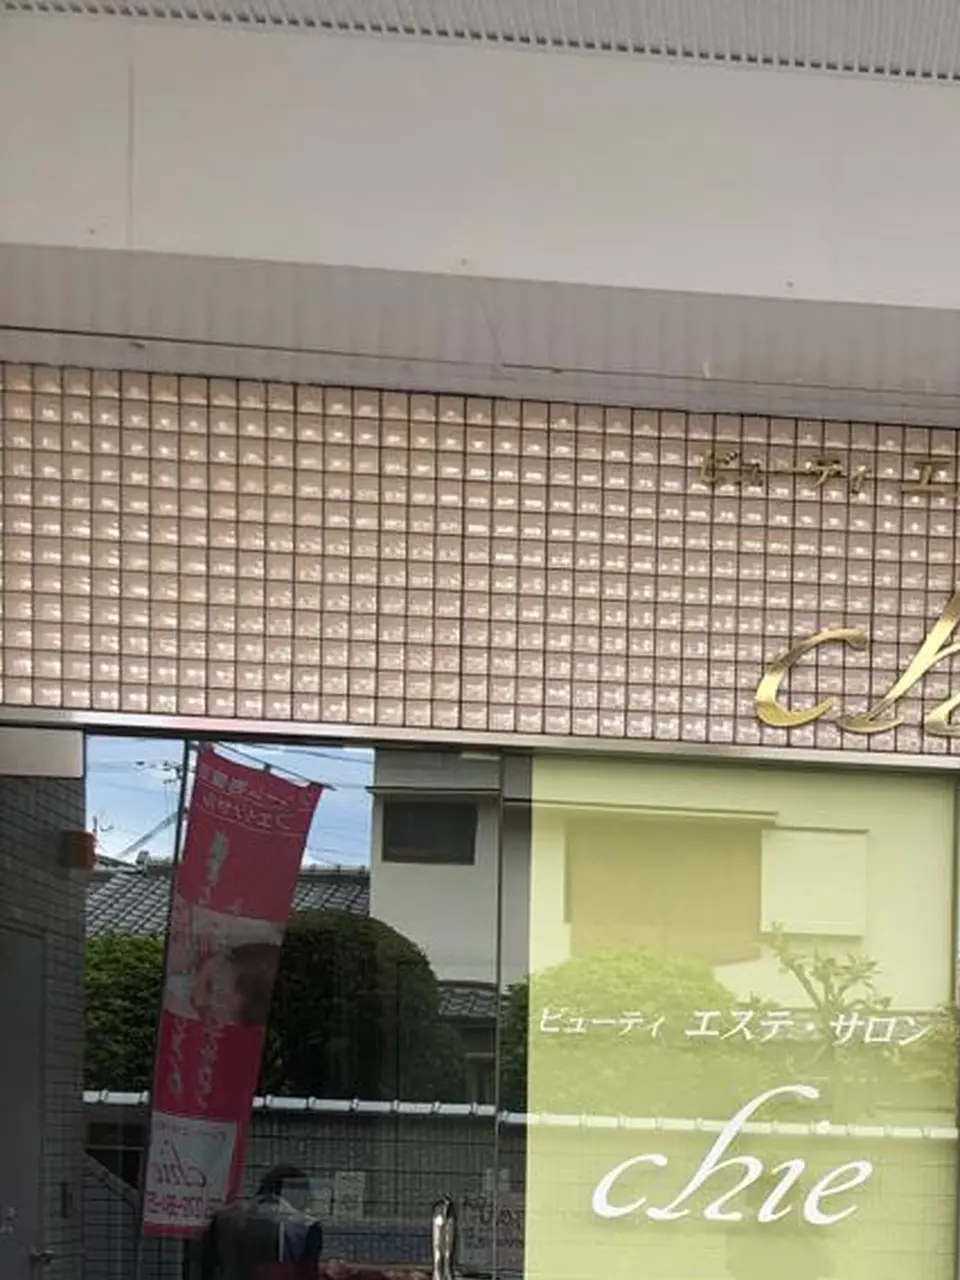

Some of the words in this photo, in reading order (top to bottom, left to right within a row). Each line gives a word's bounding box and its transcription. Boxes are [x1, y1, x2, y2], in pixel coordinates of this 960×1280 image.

[538, 1006, 666, 1037] ビューティ
[684, 1009, 936, 1047] エステ・サロン
[590, 1083, 874, 1226] chie
